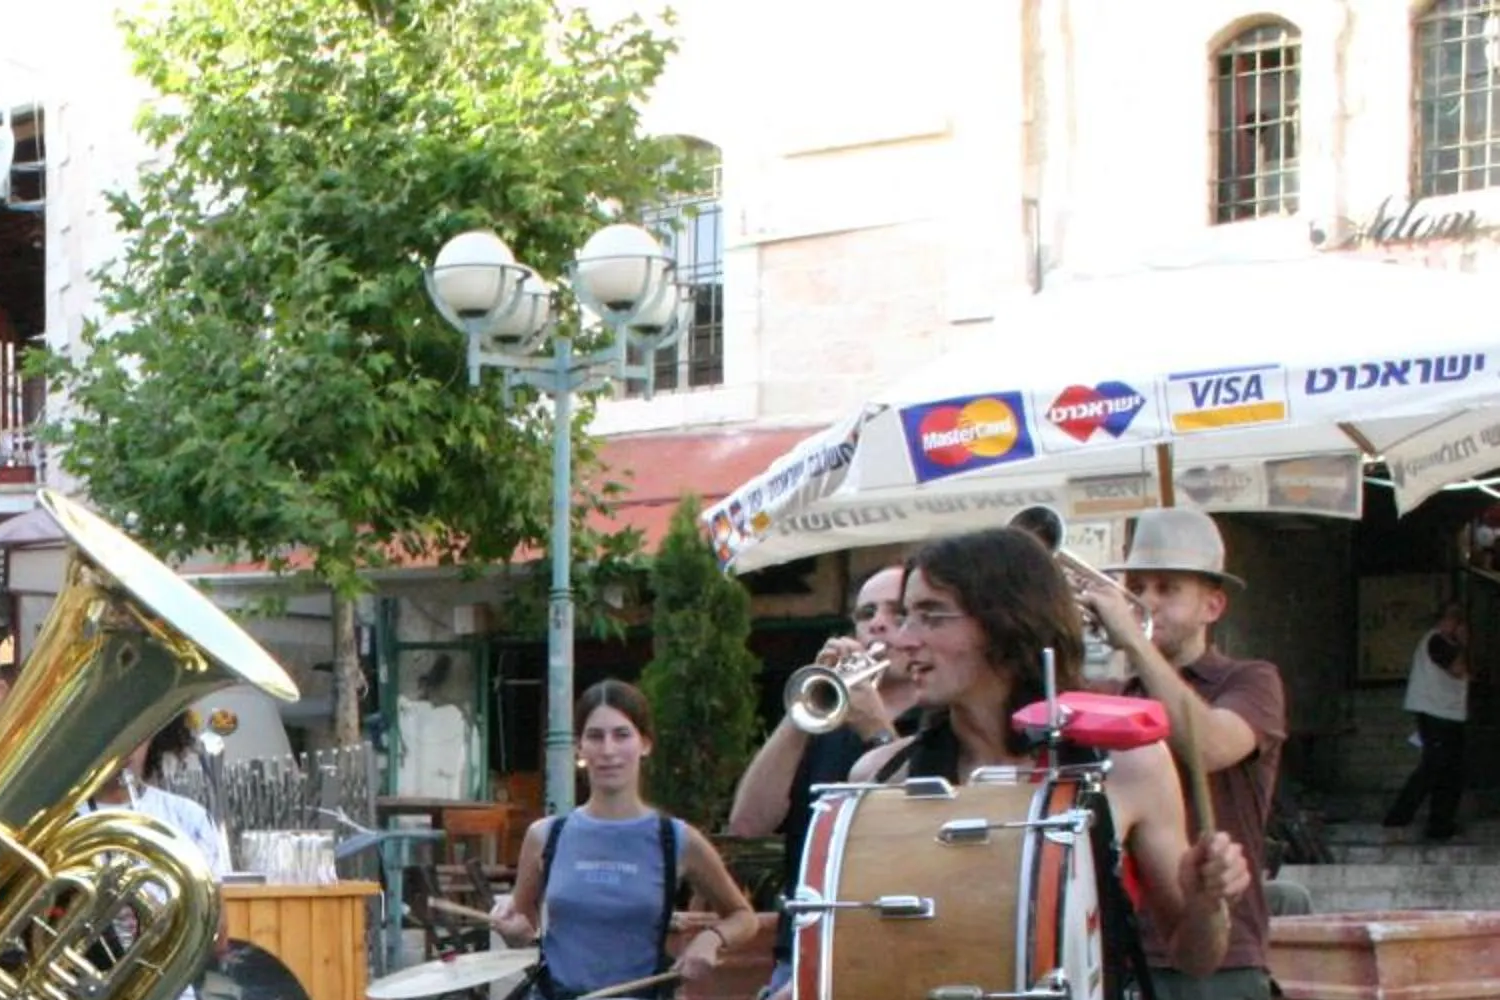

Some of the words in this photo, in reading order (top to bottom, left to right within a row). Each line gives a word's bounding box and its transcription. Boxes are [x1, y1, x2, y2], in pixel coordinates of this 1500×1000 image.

[1189, 373, 1264, 409] VISA
[1305, 352, 1485, 396] ישראכרט
[1051, 394, 1141, 423] ישראכרט
